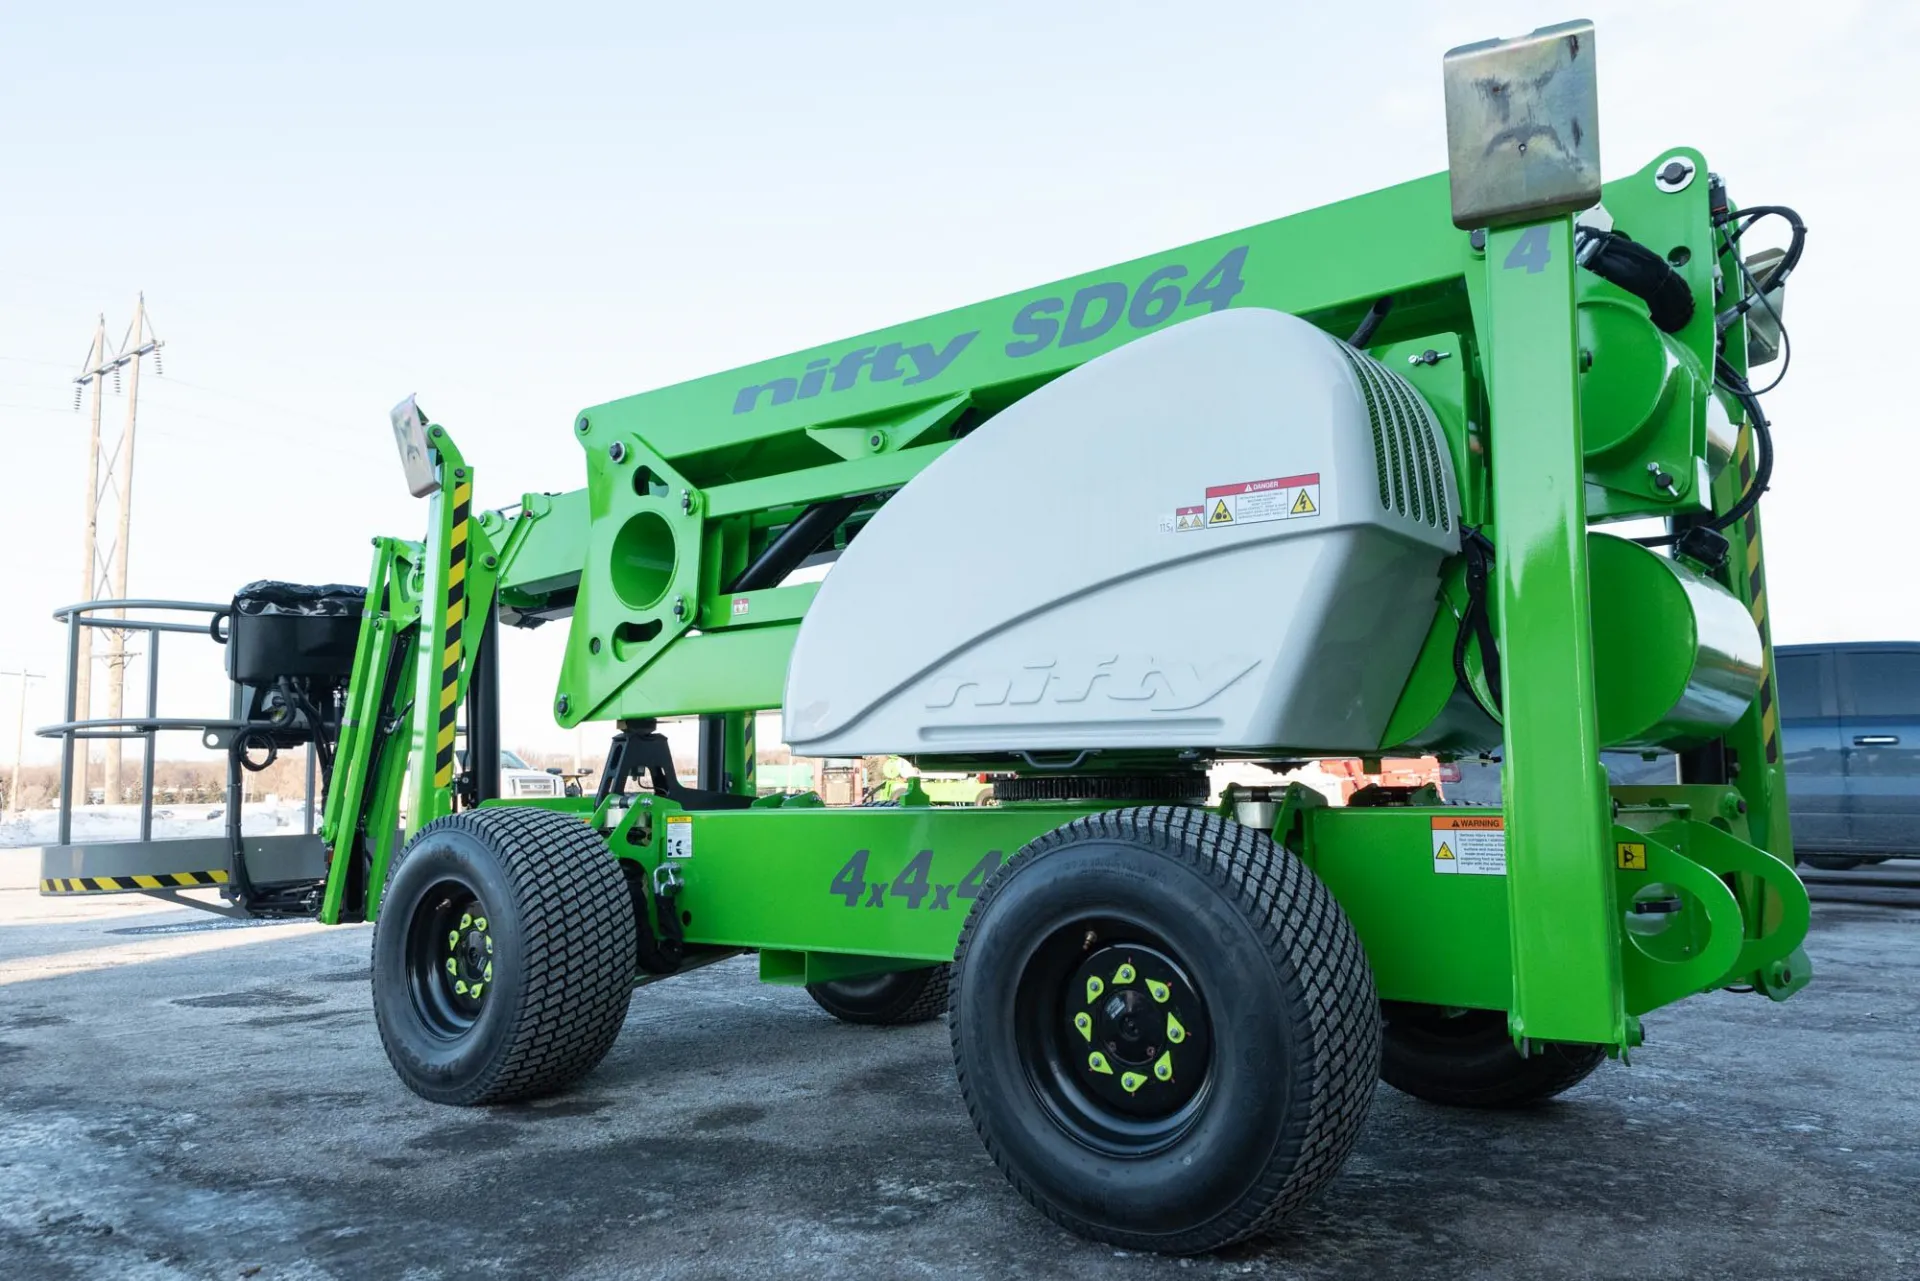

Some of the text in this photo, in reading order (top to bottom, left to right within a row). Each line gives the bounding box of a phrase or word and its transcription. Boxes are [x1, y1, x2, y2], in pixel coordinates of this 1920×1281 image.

[1503, 225, 1551, 274] 4
[732, 245, 1249, 415] nifty SD64
[1253, 481, 1279, 490] DANGER
[1461, 819, 1500, 828] WARNING
